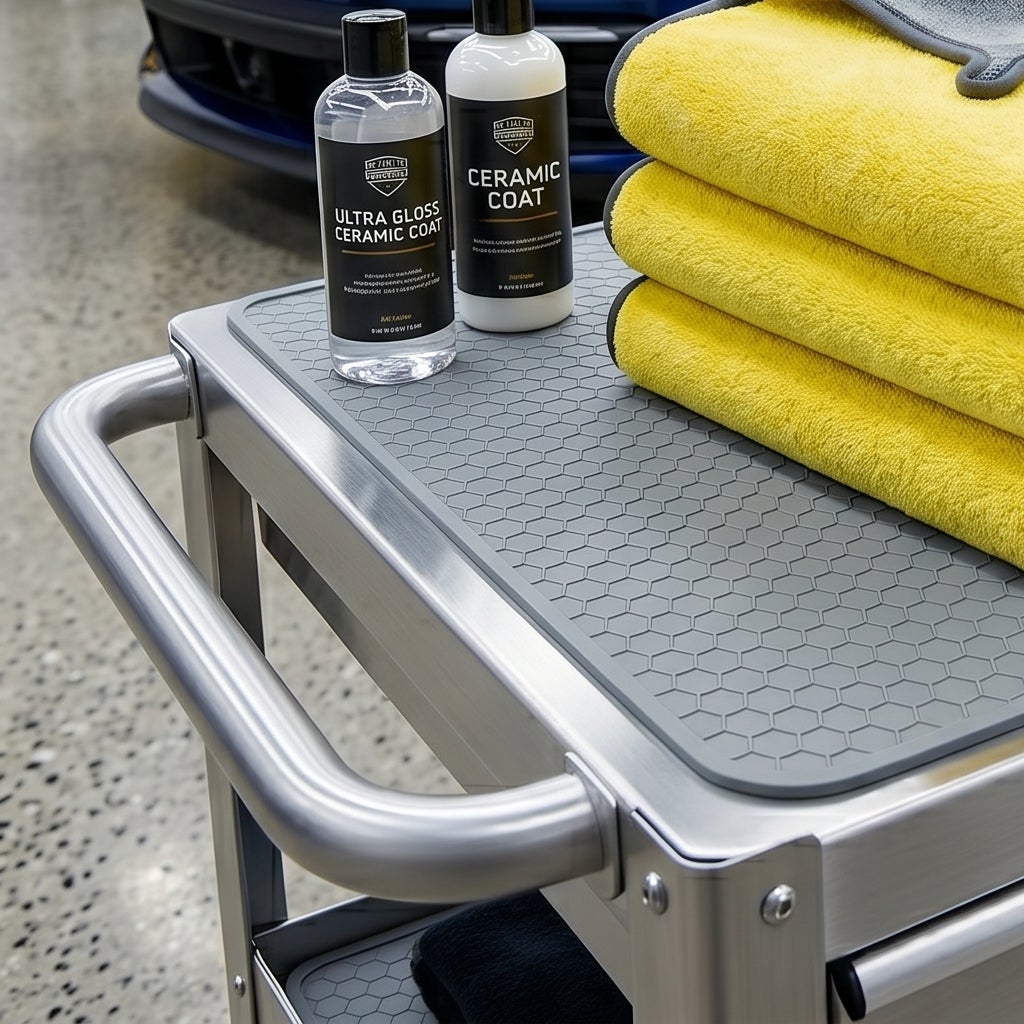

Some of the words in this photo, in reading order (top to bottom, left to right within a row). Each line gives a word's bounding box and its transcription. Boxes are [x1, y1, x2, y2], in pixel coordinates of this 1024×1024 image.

[468, 161, 561, 188] CERAMIC
[488, 187, 545, 210] COAT
[335, 207, 387, 226] ULTRA
[392, 200, 440, 225] GLOSS
[335, 226, 404, 243] CERAMIC
[409, 217, 443, 239] COAT
